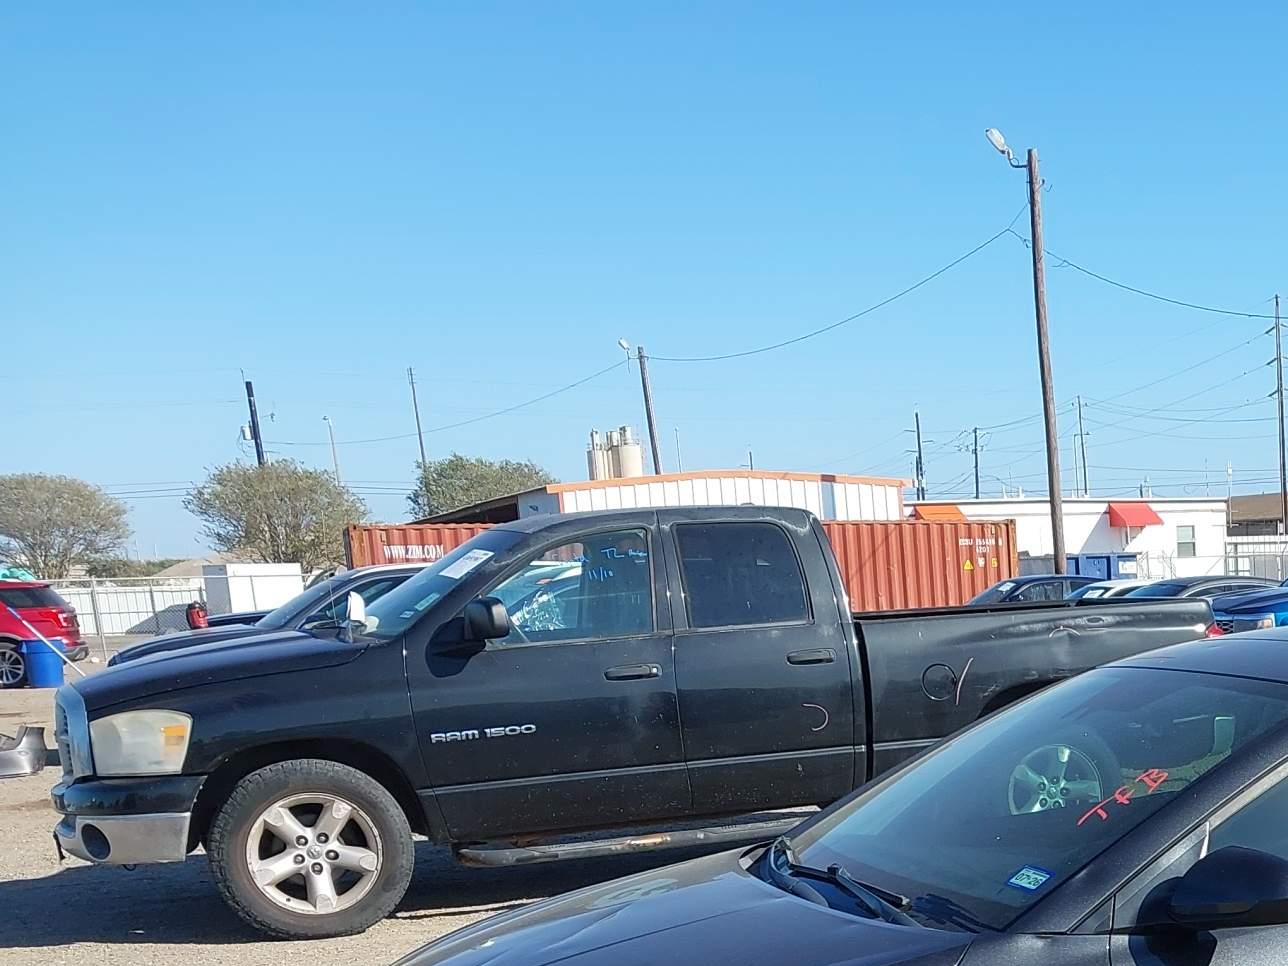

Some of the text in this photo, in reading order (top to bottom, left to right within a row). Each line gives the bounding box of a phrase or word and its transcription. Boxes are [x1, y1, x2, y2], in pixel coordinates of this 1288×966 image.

[383, 544, 444, 559] WWW.ZIM.COM
[430, 724, 537, 744] RAM 1500
